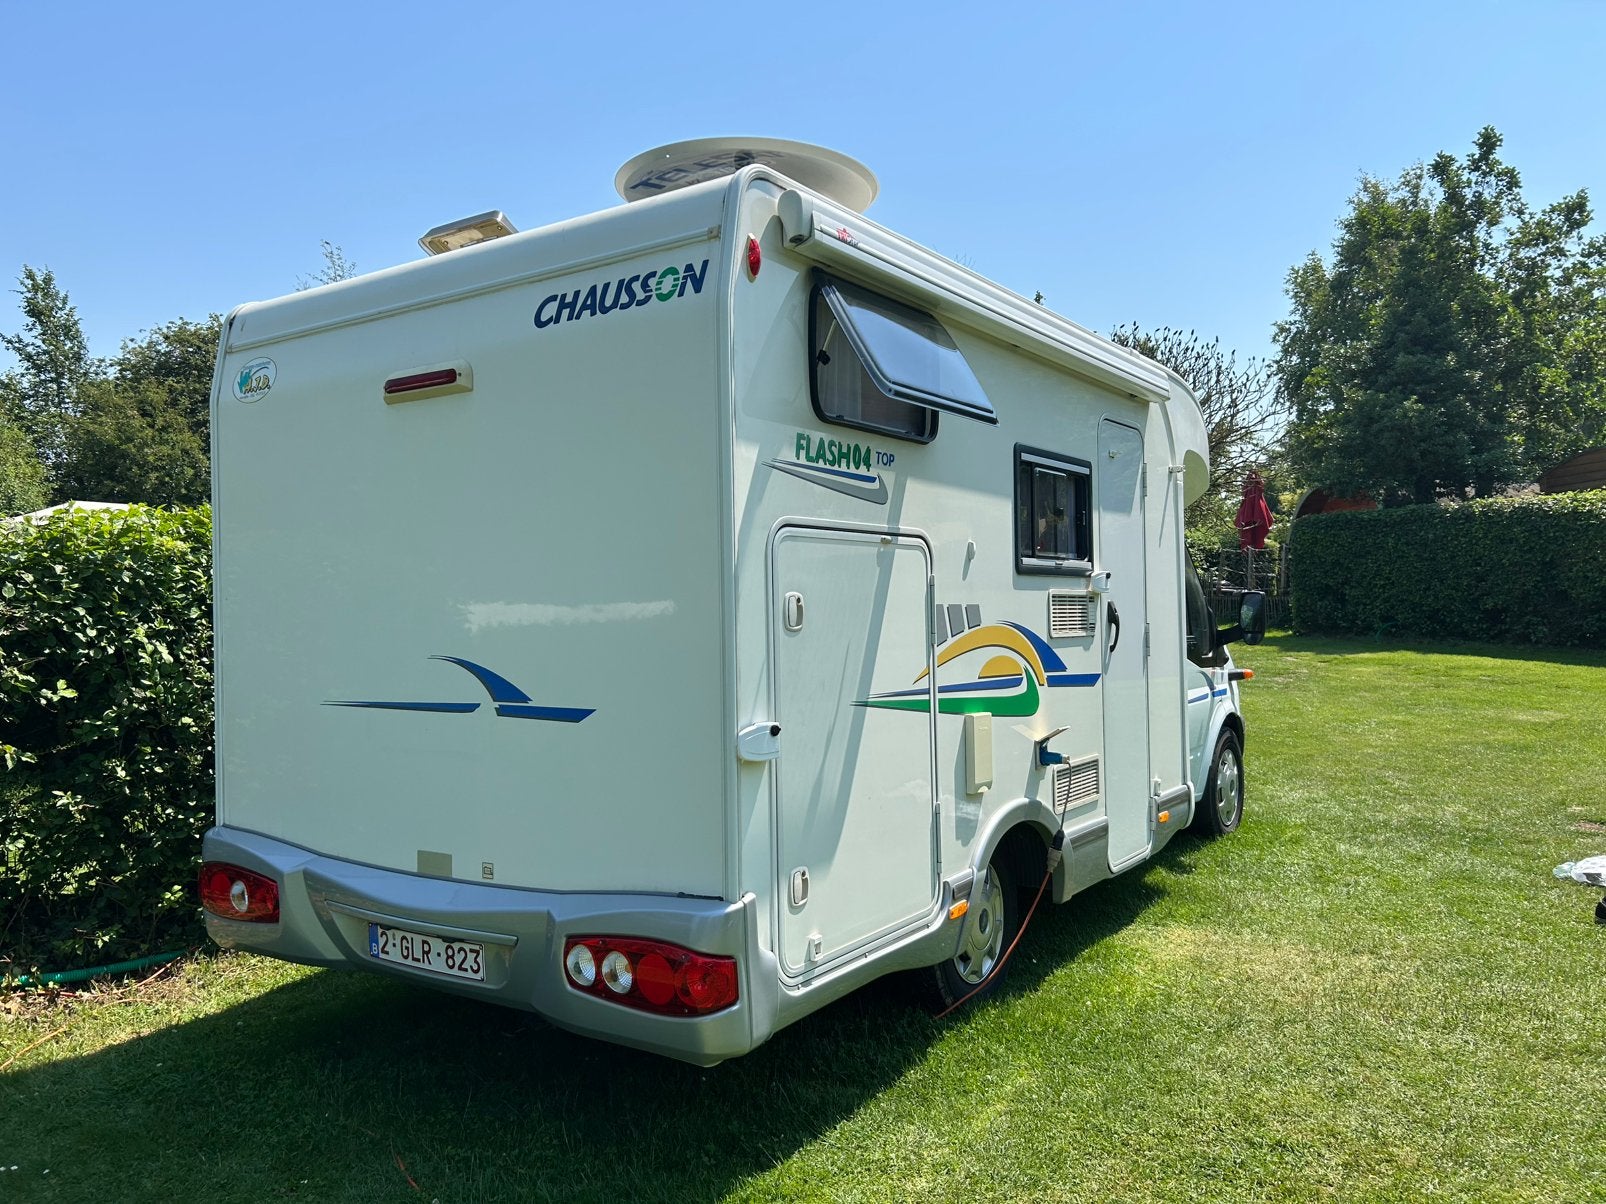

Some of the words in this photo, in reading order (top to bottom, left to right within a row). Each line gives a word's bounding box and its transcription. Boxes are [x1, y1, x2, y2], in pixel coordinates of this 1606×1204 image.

[533, 259, 709, 329] CHAUSSON
[795, 432, 872, 472] FLASH04
[876, 451, 895, 467] TOP
[372, 943, 379, 955] B
